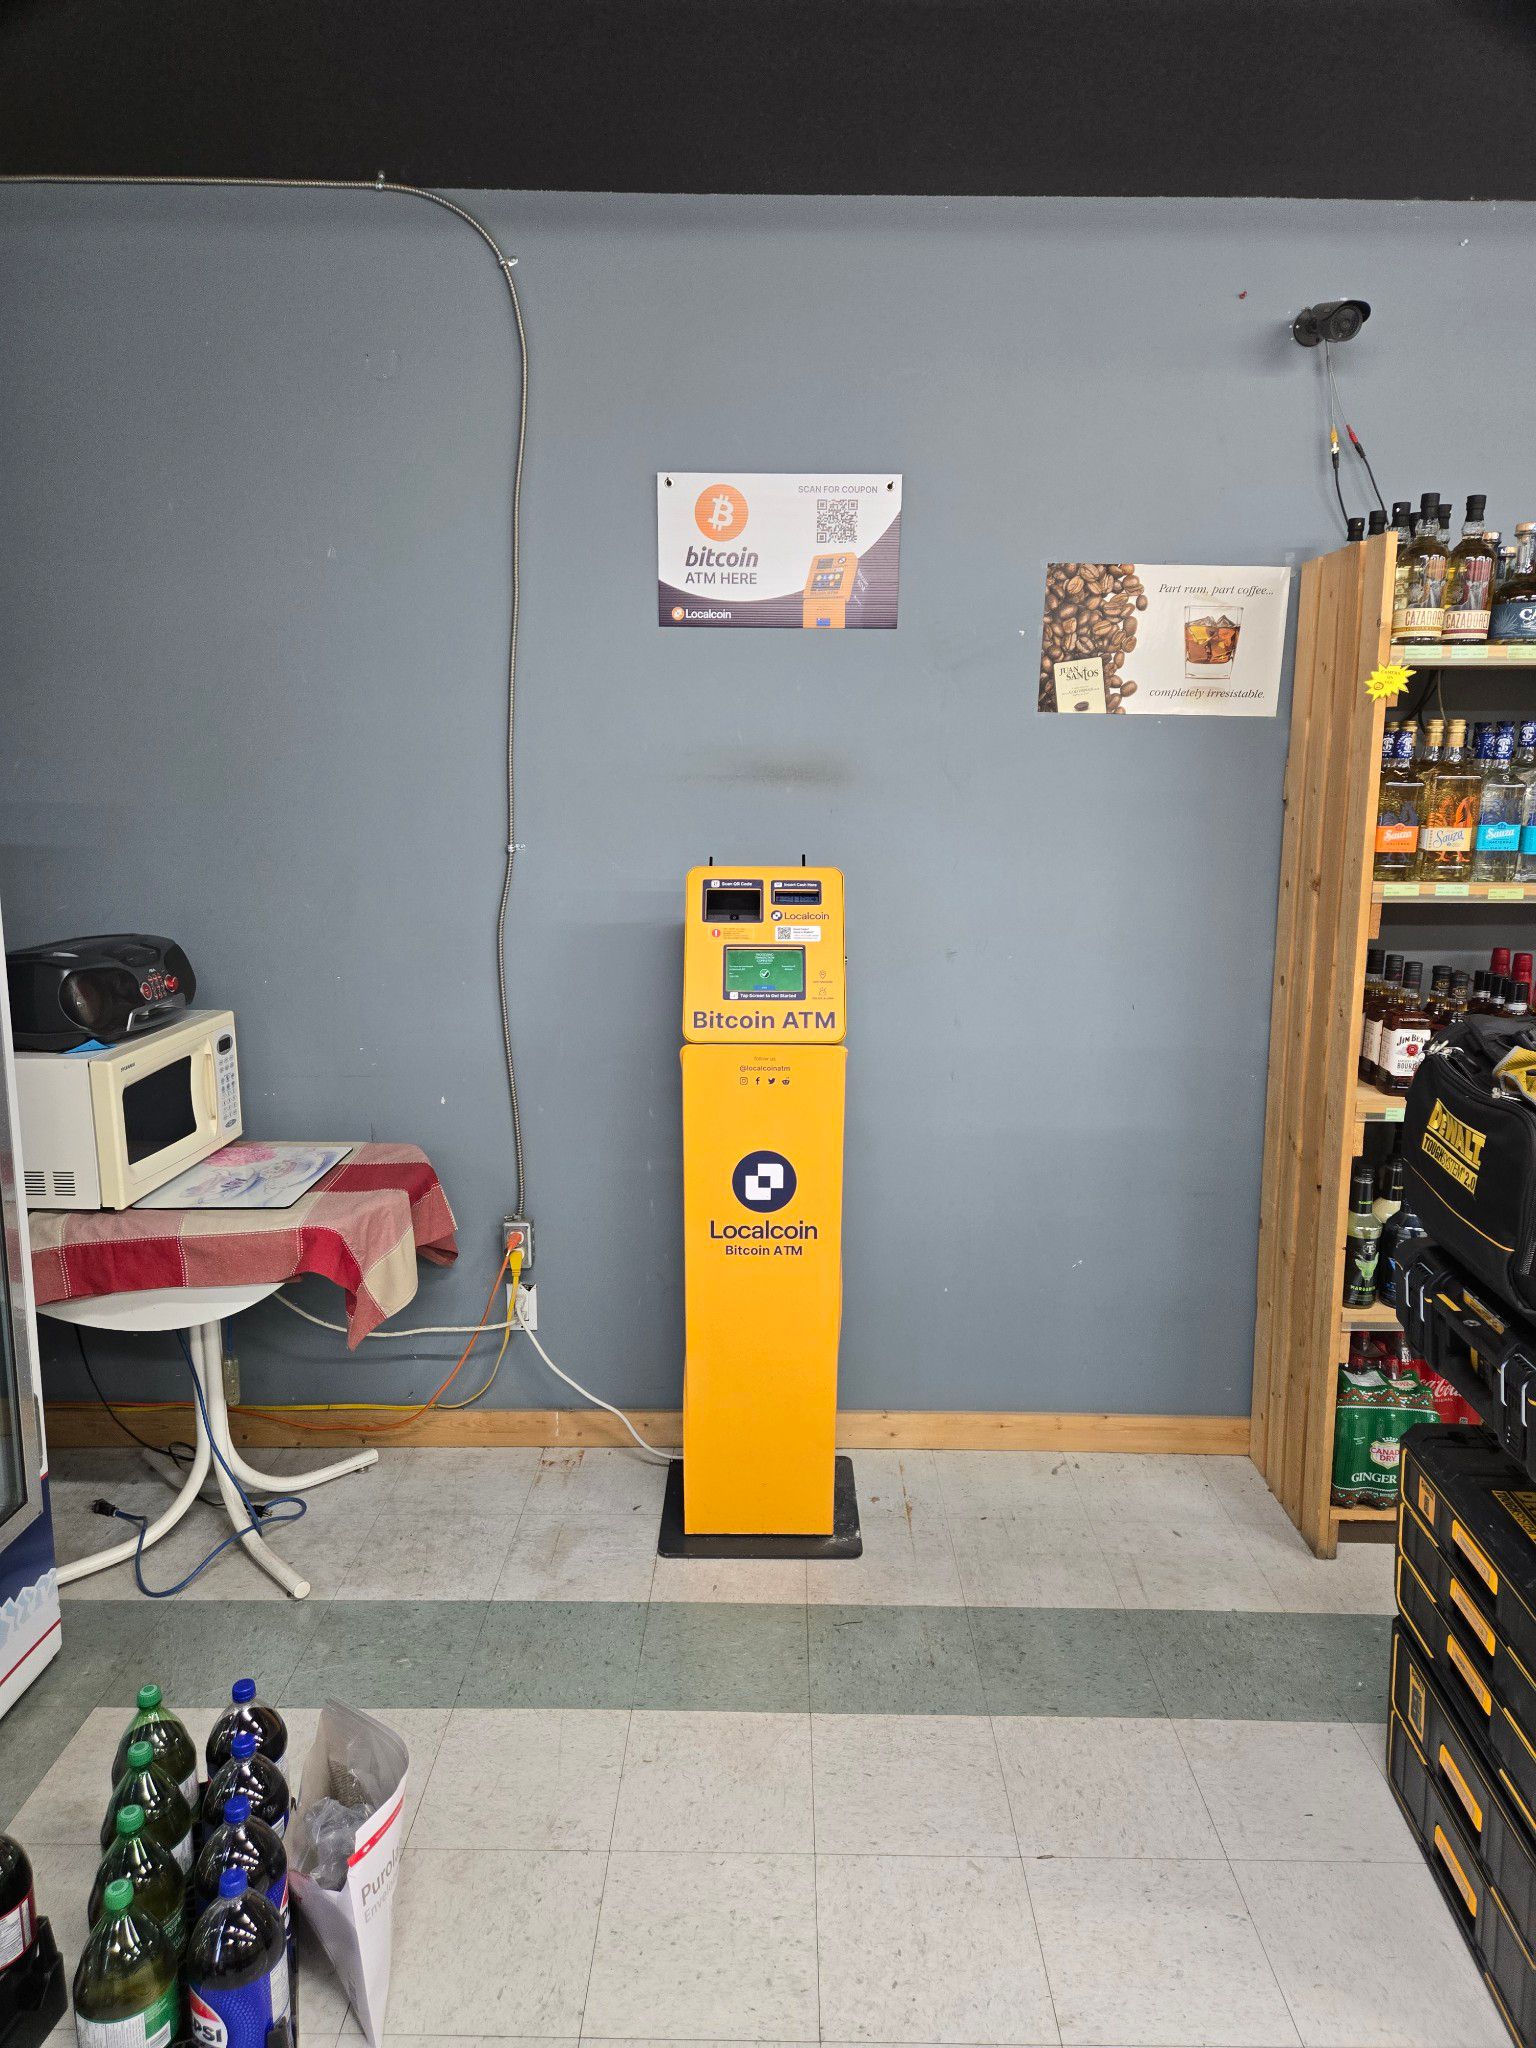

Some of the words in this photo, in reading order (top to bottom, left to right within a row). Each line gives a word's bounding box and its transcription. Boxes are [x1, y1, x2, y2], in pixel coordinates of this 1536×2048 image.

[798, 485, 822, 494] SCAN
[823, 485, 840, 494] FOR
[841, 485, 878, 494] COUPON
[685, 546, 759, 568] bitcoin
[685, 572, 716, 584] ATM
[721, 572, 758, 585] HERE
[1158, 583, 1182, 594] Part
[1211, 584, 1236, 597] part
[685, 608, 732, 619] Localcoin
[1149, 688, 1205, 699] completely
[1433, 829, 1464, 848] Sauza
[1485, 828, 1515, 840] Sauza
[784, 912, 830, 920] Localcoin
[693, 1011, 775, 1029] Bitcoin
[782, 1011, 836, 1029] ATM
[1411, 1034, 1425, 1044] BEA
[710, 1220, 818, 1240] Localcoin
[725, 1245, 770, 1256] Bitcoin
[773, 1245, 803, 1256] ATM
[1351, 1472, 1397, 1484] GINGER
